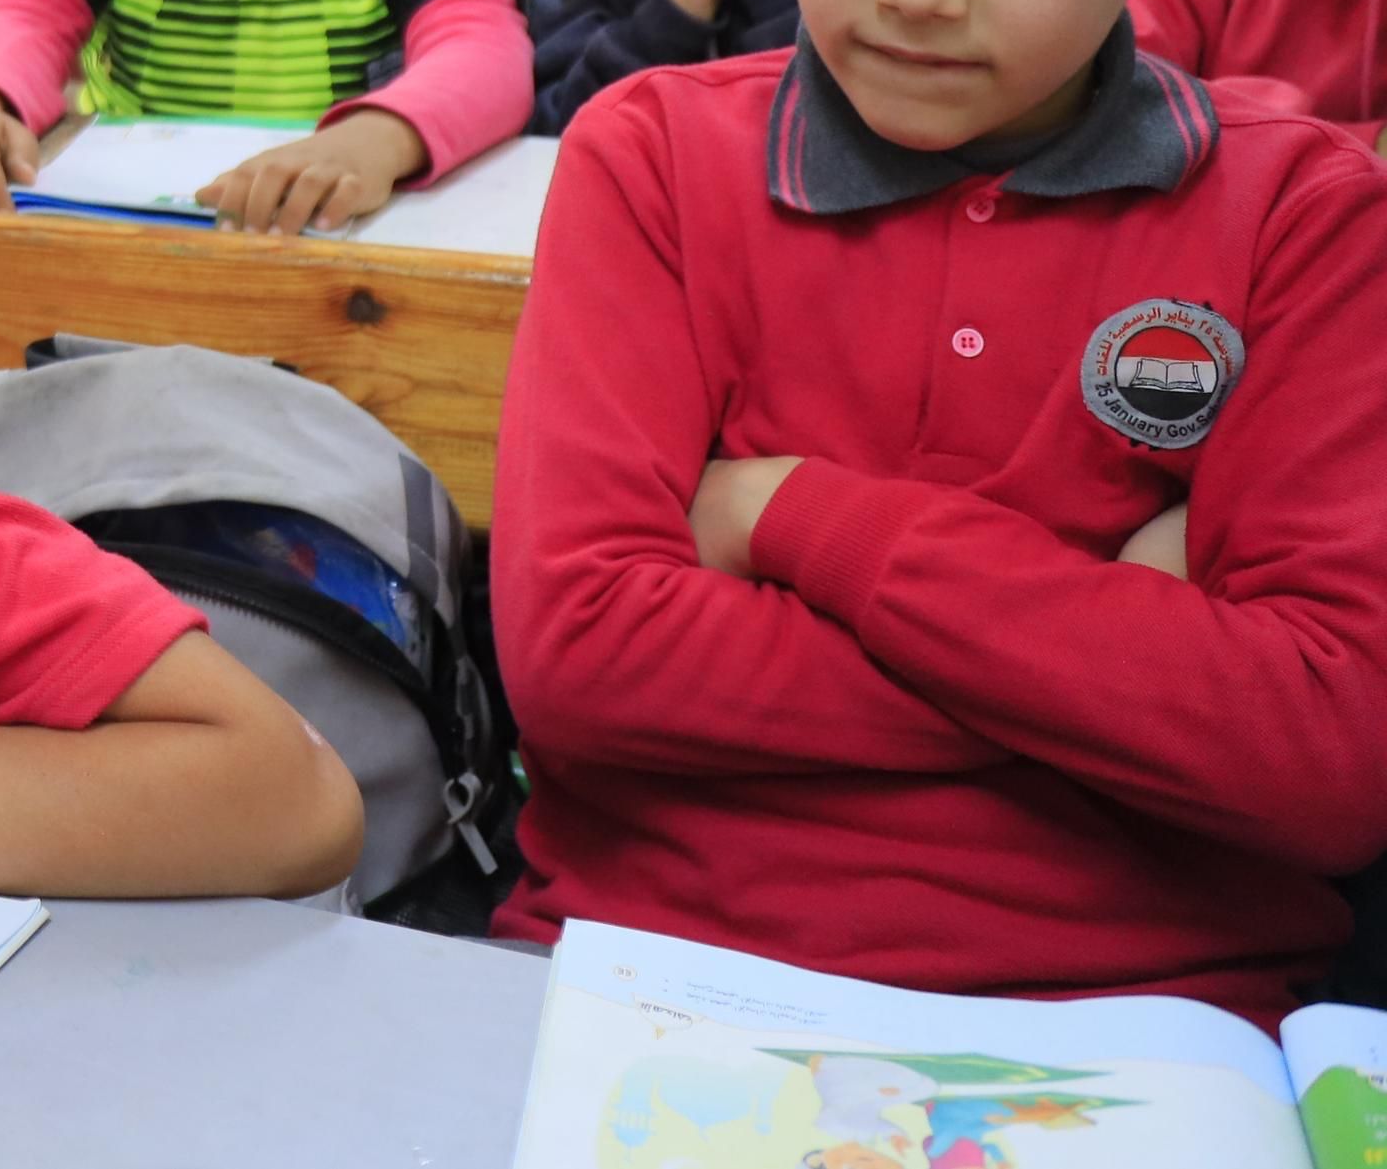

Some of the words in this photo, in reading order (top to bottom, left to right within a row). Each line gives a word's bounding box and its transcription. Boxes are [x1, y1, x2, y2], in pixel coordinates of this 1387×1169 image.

[1163, 308, 1195, 327] يناير
[1095, 382, 1114, 398] 25
[1105, 396, 1163, 438] January
[640, 1002, 692, 1022] الأهداف
